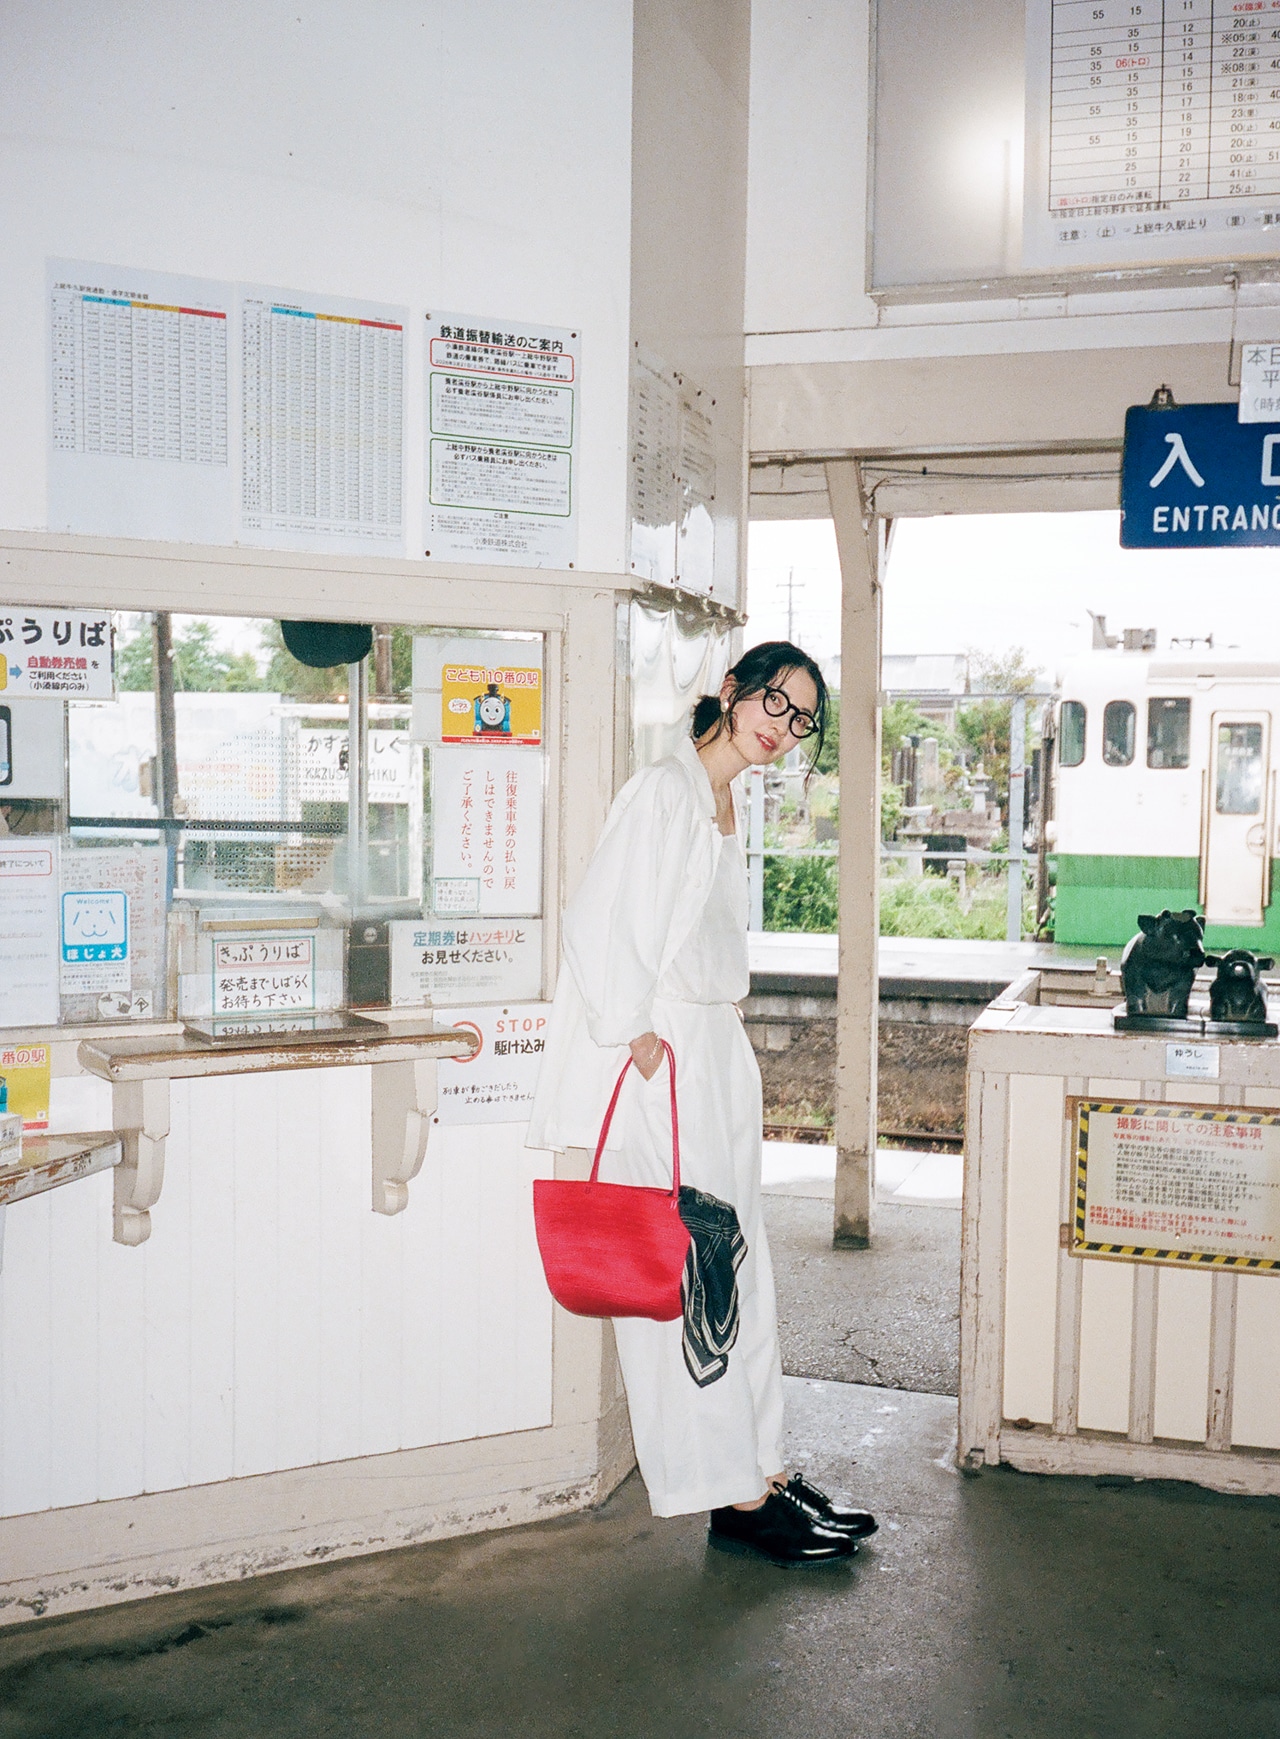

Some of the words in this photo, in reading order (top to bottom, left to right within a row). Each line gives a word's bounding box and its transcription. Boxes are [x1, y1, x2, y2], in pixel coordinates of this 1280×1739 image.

[1184, 1, 1193, 10] 11
[1092, 10, 1104, 20] 55
[1130, 6, 1142, 16] 15
[1128, 28, 1139, 38] 35
[1183, 24, 1194, 32] 12
[1182, 38, 1194, 46] 13
[1090, 46, 1102, 56] 55
[1128, 43, 1139, 52] 15
[1182, 52, 1194, 61] 14
[1090, 62, 1102, 70] 35
[1182, 68, 1194, 76] 15
[1090, 76, 1102, 86] 55
[1128, 73, 1138, 82] 15
[1126, 88, 1138, 96] 35
[1182, 82, 1192, 92] 16
[1128, 102, 1138, 112] 15
[1182, 98, 1192, 106] 17
[1089, 106, 1101, 115] 55
[1126, 117, 1138, 126] 35
[1181, 112, 1192, 122] 18
[1127, 132, 1138, 142] 15
[1181, 128, 1192, 136] 19
[1089, 136, 1100, 144] 55
[1180, 142, 1192, 152] 20
[1126, 148, 1137, 157] 35
[1125, 162, 1136, 172] 25
[1180, 158, 1190, 167] 21
[1126, 177, 1136, 186] 15
[1178, 173, 1190, 182] 22
[1178, 188, 1190, 198] 23
[440, 324, 563, 353] 鉄道振替輸送のご案内
[29, 671, 88, 681] ご利用ください
[446, 669, 538, 685] こども110番の駅
[461, 769, 474, 869] ご了承ください。
[483, 770, 495, 889] しはできませんので
[504, 770, 518, 890] 往復乗車券の払い戻
[413, 930, 525, 946] 定期券はハッキリと
[66, 948, 124, 960] ほじょ犬
[219, 943, 304, 964] きっぷうりば
[422, 950, 513, 965] お見せください。
[219, 974, 308, 993] 発売までしばらく
[222, 993, 302, 1010] お待ち下さい
[496, 1017, 546, 1033] STOP
[494, 1038, 545, 1056] 駆け込み
[2, 1048, 45, 1064] 番の駅
[1116, 1117, 1262, 1140] 撮影に関しての注意事項
